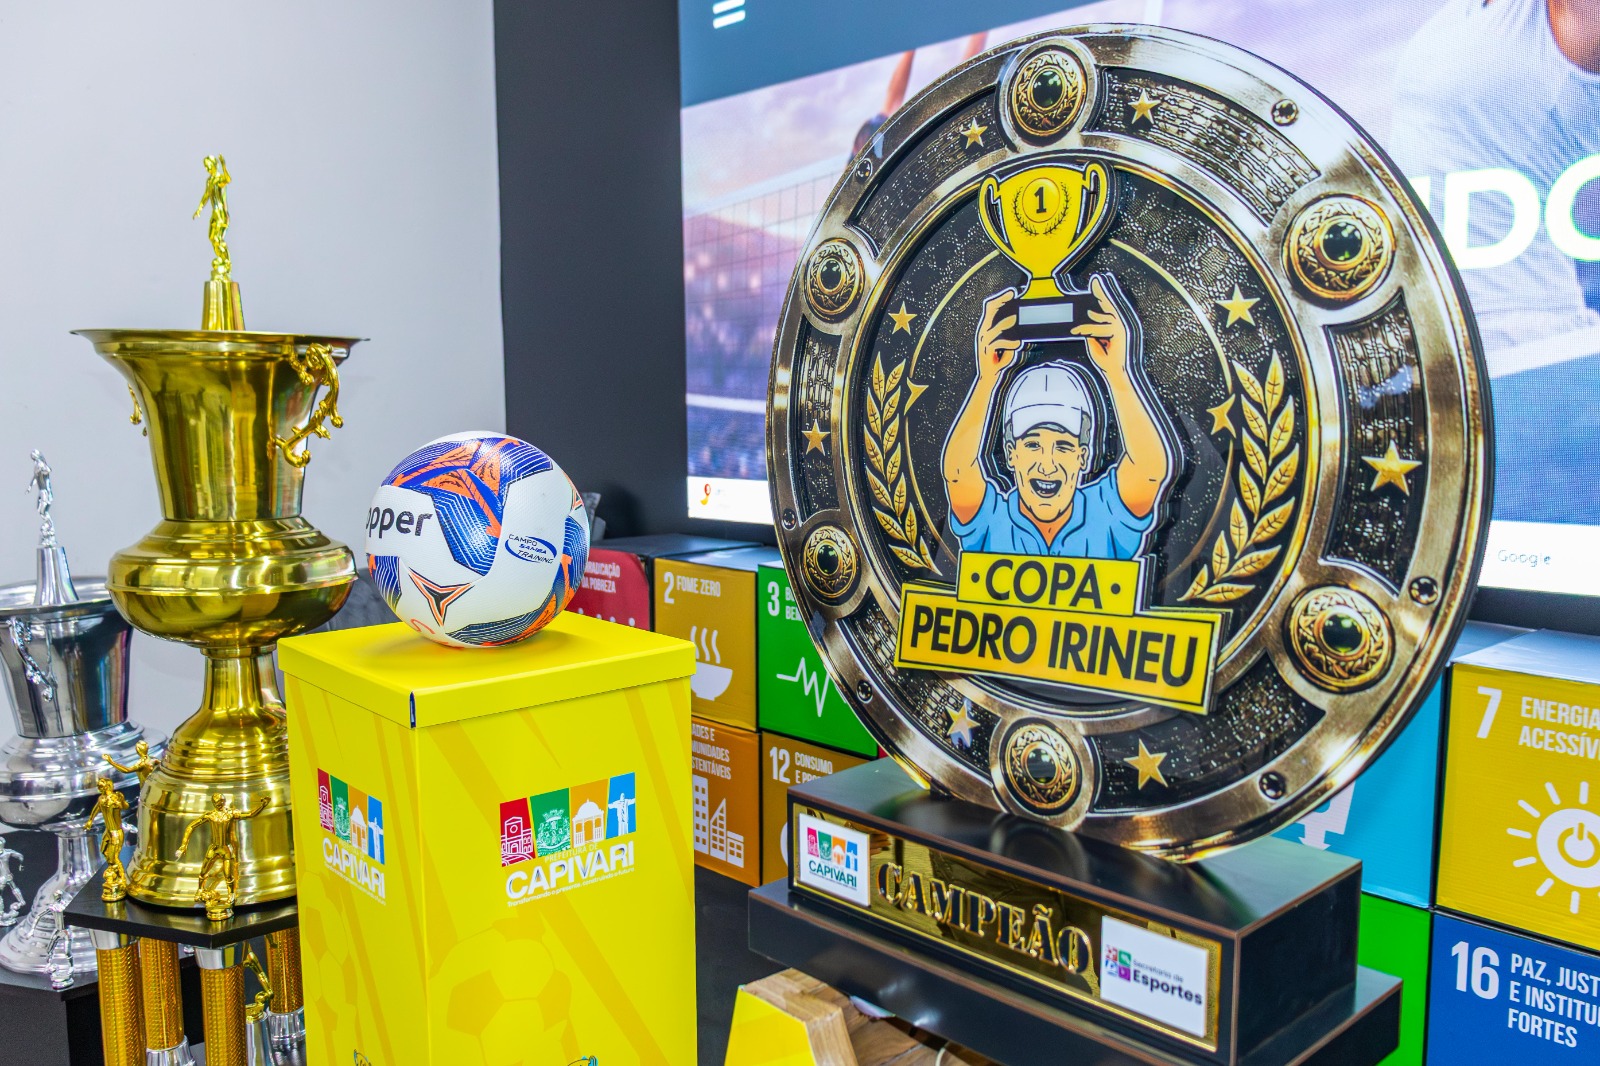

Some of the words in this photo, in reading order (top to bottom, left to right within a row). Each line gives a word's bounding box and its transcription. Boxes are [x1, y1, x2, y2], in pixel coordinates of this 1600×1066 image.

[1034, 186, 1047, 214] 1
[508, 534, 538, 547] CAMPO
[518, 549, 555, 565] TRAINING
[590, 577, 616, 594] POBREZA
[664, 571, 675, 604] 2
[676, 575, 699, 594] FOME
[700, 578, 721, 597] ZERO
[767, 581, 780, 617] 3
[985, 558, 1103, 609] COPA
[910, 604, 1037, 664] PEDRO
[1048, 620, 1198, 688] IRINEU
[1477, 686, 1502, 739] 7
[1521, 696, 1600, 730] ENERGIA
[710, 728, 715, 741] E
[1518, 725, 1600, 761] ACESSÍV
[770, 746, 790, 784] 12
[795, 751, 832, 775] CONSUMO
[796, 769, 801, 784] E
[323, 837, 386, 899] CAPIVARI
[506, 841, 635, 899] CAPIVARI
[808, 860, 857, 888] CAPIVARI
[876, 862, 1093, 975] CAMPEÃO
[1451, 941, 1500, 1000] 16
[1510, 953, 1551, 986] PAZ,
[1133, 969, 1203, 1006] Esportes
[1509, 980, 1521, 1003] E
[1507, 1007, 1578, 1048] FORTES
